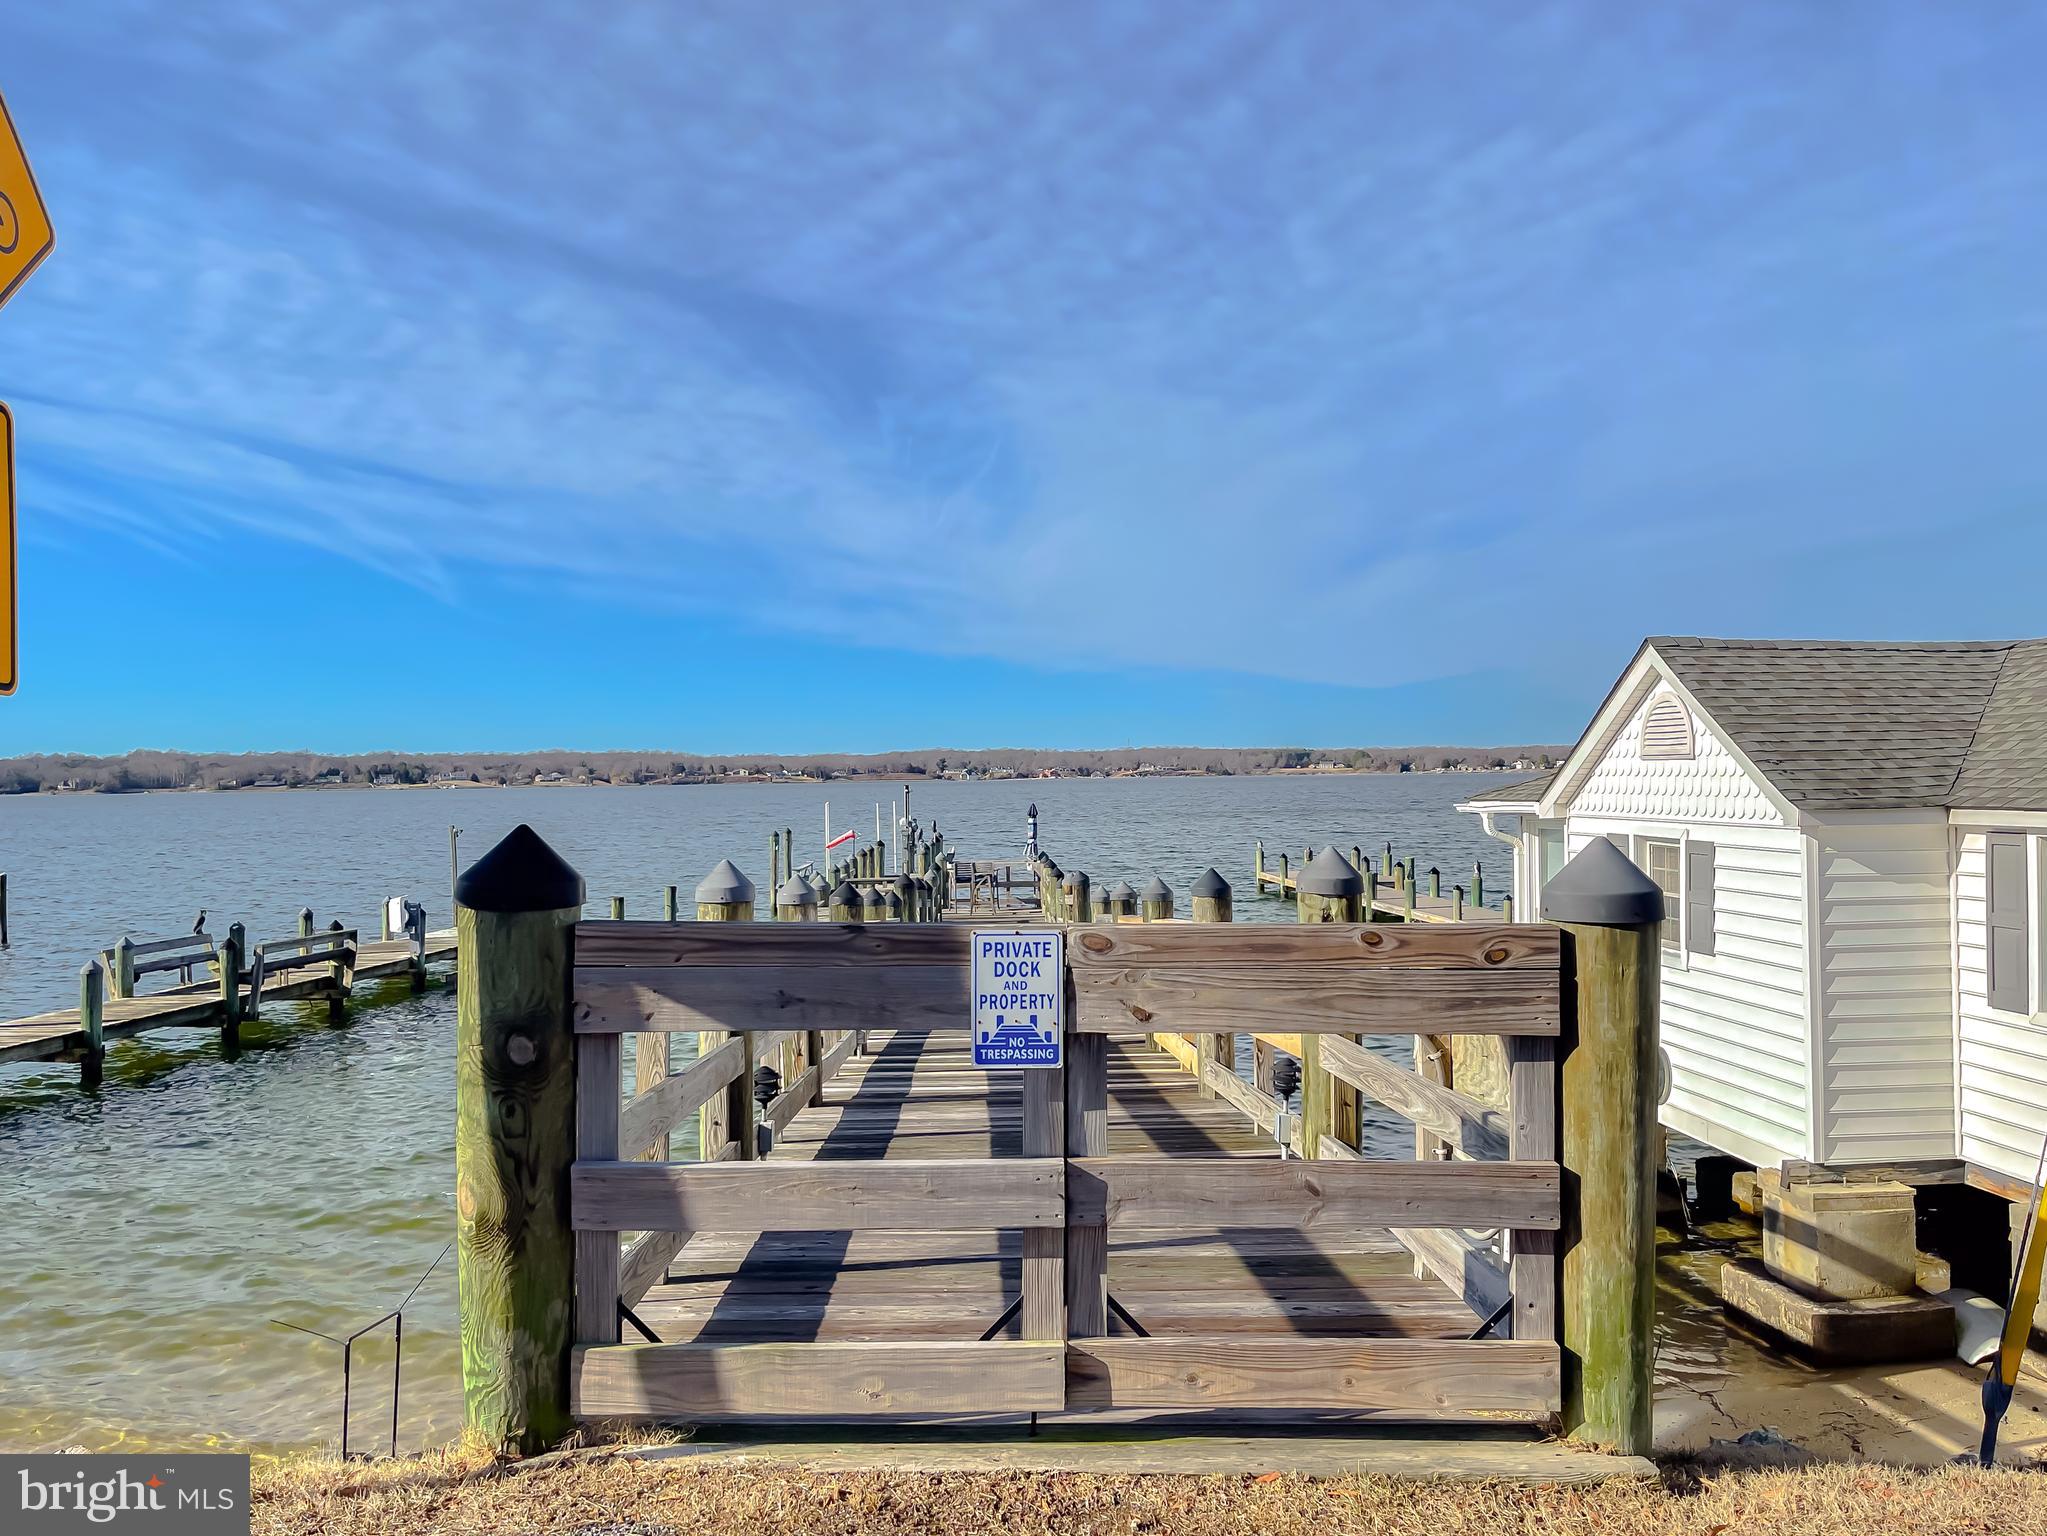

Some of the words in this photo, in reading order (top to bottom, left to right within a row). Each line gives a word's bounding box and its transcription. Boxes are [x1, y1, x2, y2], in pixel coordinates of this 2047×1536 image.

[983, 942, 1052, 958] PRIVATE
[994, 961, 1041, 978] DOCK
[1003, 981, 1028, 991] AND
[980, 994, 1055, 1010] PROPERTY
[1009, 1038, 1025, 1047] NO
[980, 1049, 1054, 1060] TRESPASSING
